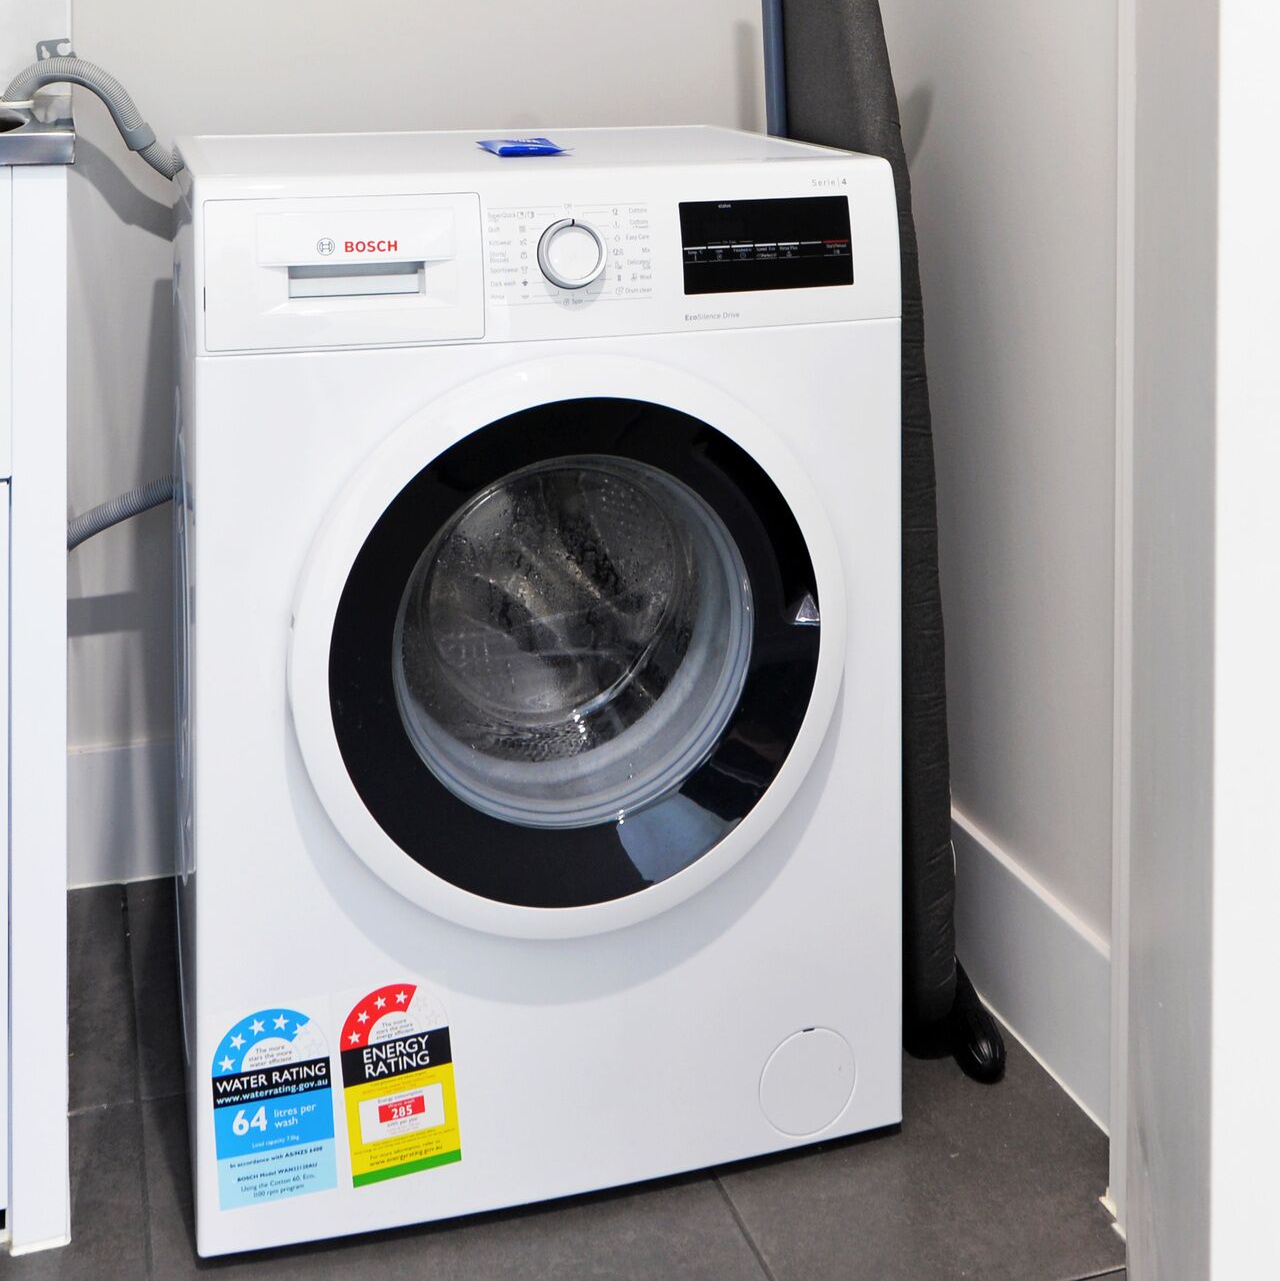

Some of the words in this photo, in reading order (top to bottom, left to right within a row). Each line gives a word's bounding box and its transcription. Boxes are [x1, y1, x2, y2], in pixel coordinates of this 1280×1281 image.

[344, 240, 398, 253] BOSCH
[363, 1034, 429, 1064] ENERGY
[216, 1073, 268, 1094] WATER
[272, 1063, 326, 1084] RATING
[365, 1051, 430, 1079] RATING
[216, 1078, 328, 1105] www.waterrating.gov.au
[232, 1106, 267, 1136] 64
[274, 1107, 298, 1118] litres
[300, 1104, 316, 1116] per
[275, 1116, 298, 1129] wash
[392, 1105, 413, 1119] 285
